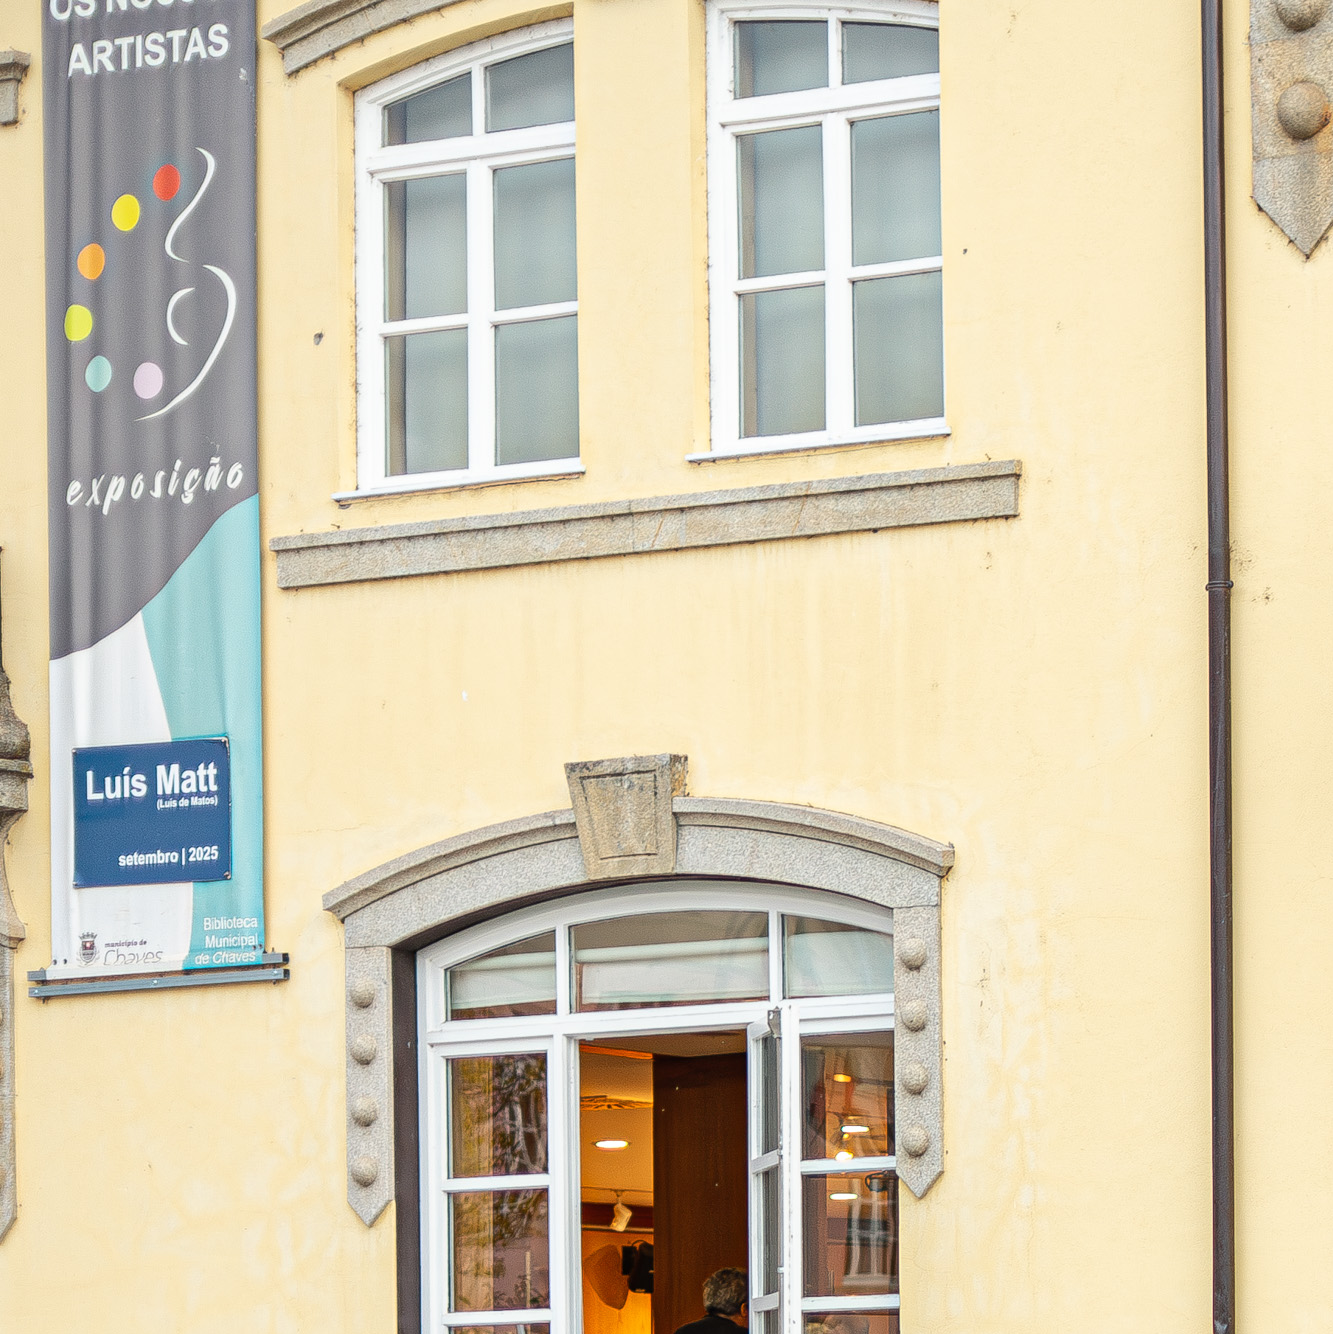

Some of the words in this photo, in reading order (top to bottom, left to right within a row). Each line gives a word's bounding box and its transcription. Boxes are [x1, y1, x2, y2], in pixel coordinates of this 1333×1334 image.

[68, 23, 230, 77] ARTISTAS
[66, 456, 244, 515] exposição
[86, 766, 147, 800] Luís
[156, 762, 218, 795] Matt
[179, 797, 189, 807] de
[191, 795, 218, 807] Matos)
[118, 849, 178, 866] setembro
[188, 846, 219, 862] 2025
[203, 916, 258, 931] Biblioteca
[139, 938, 147, 946] de
[205, 932, 258, 950] Municipal
[103, 948, 163, 966] Chaves
[195, 953, 212, 966] de
[214, 951, 256, 964] Chaves
